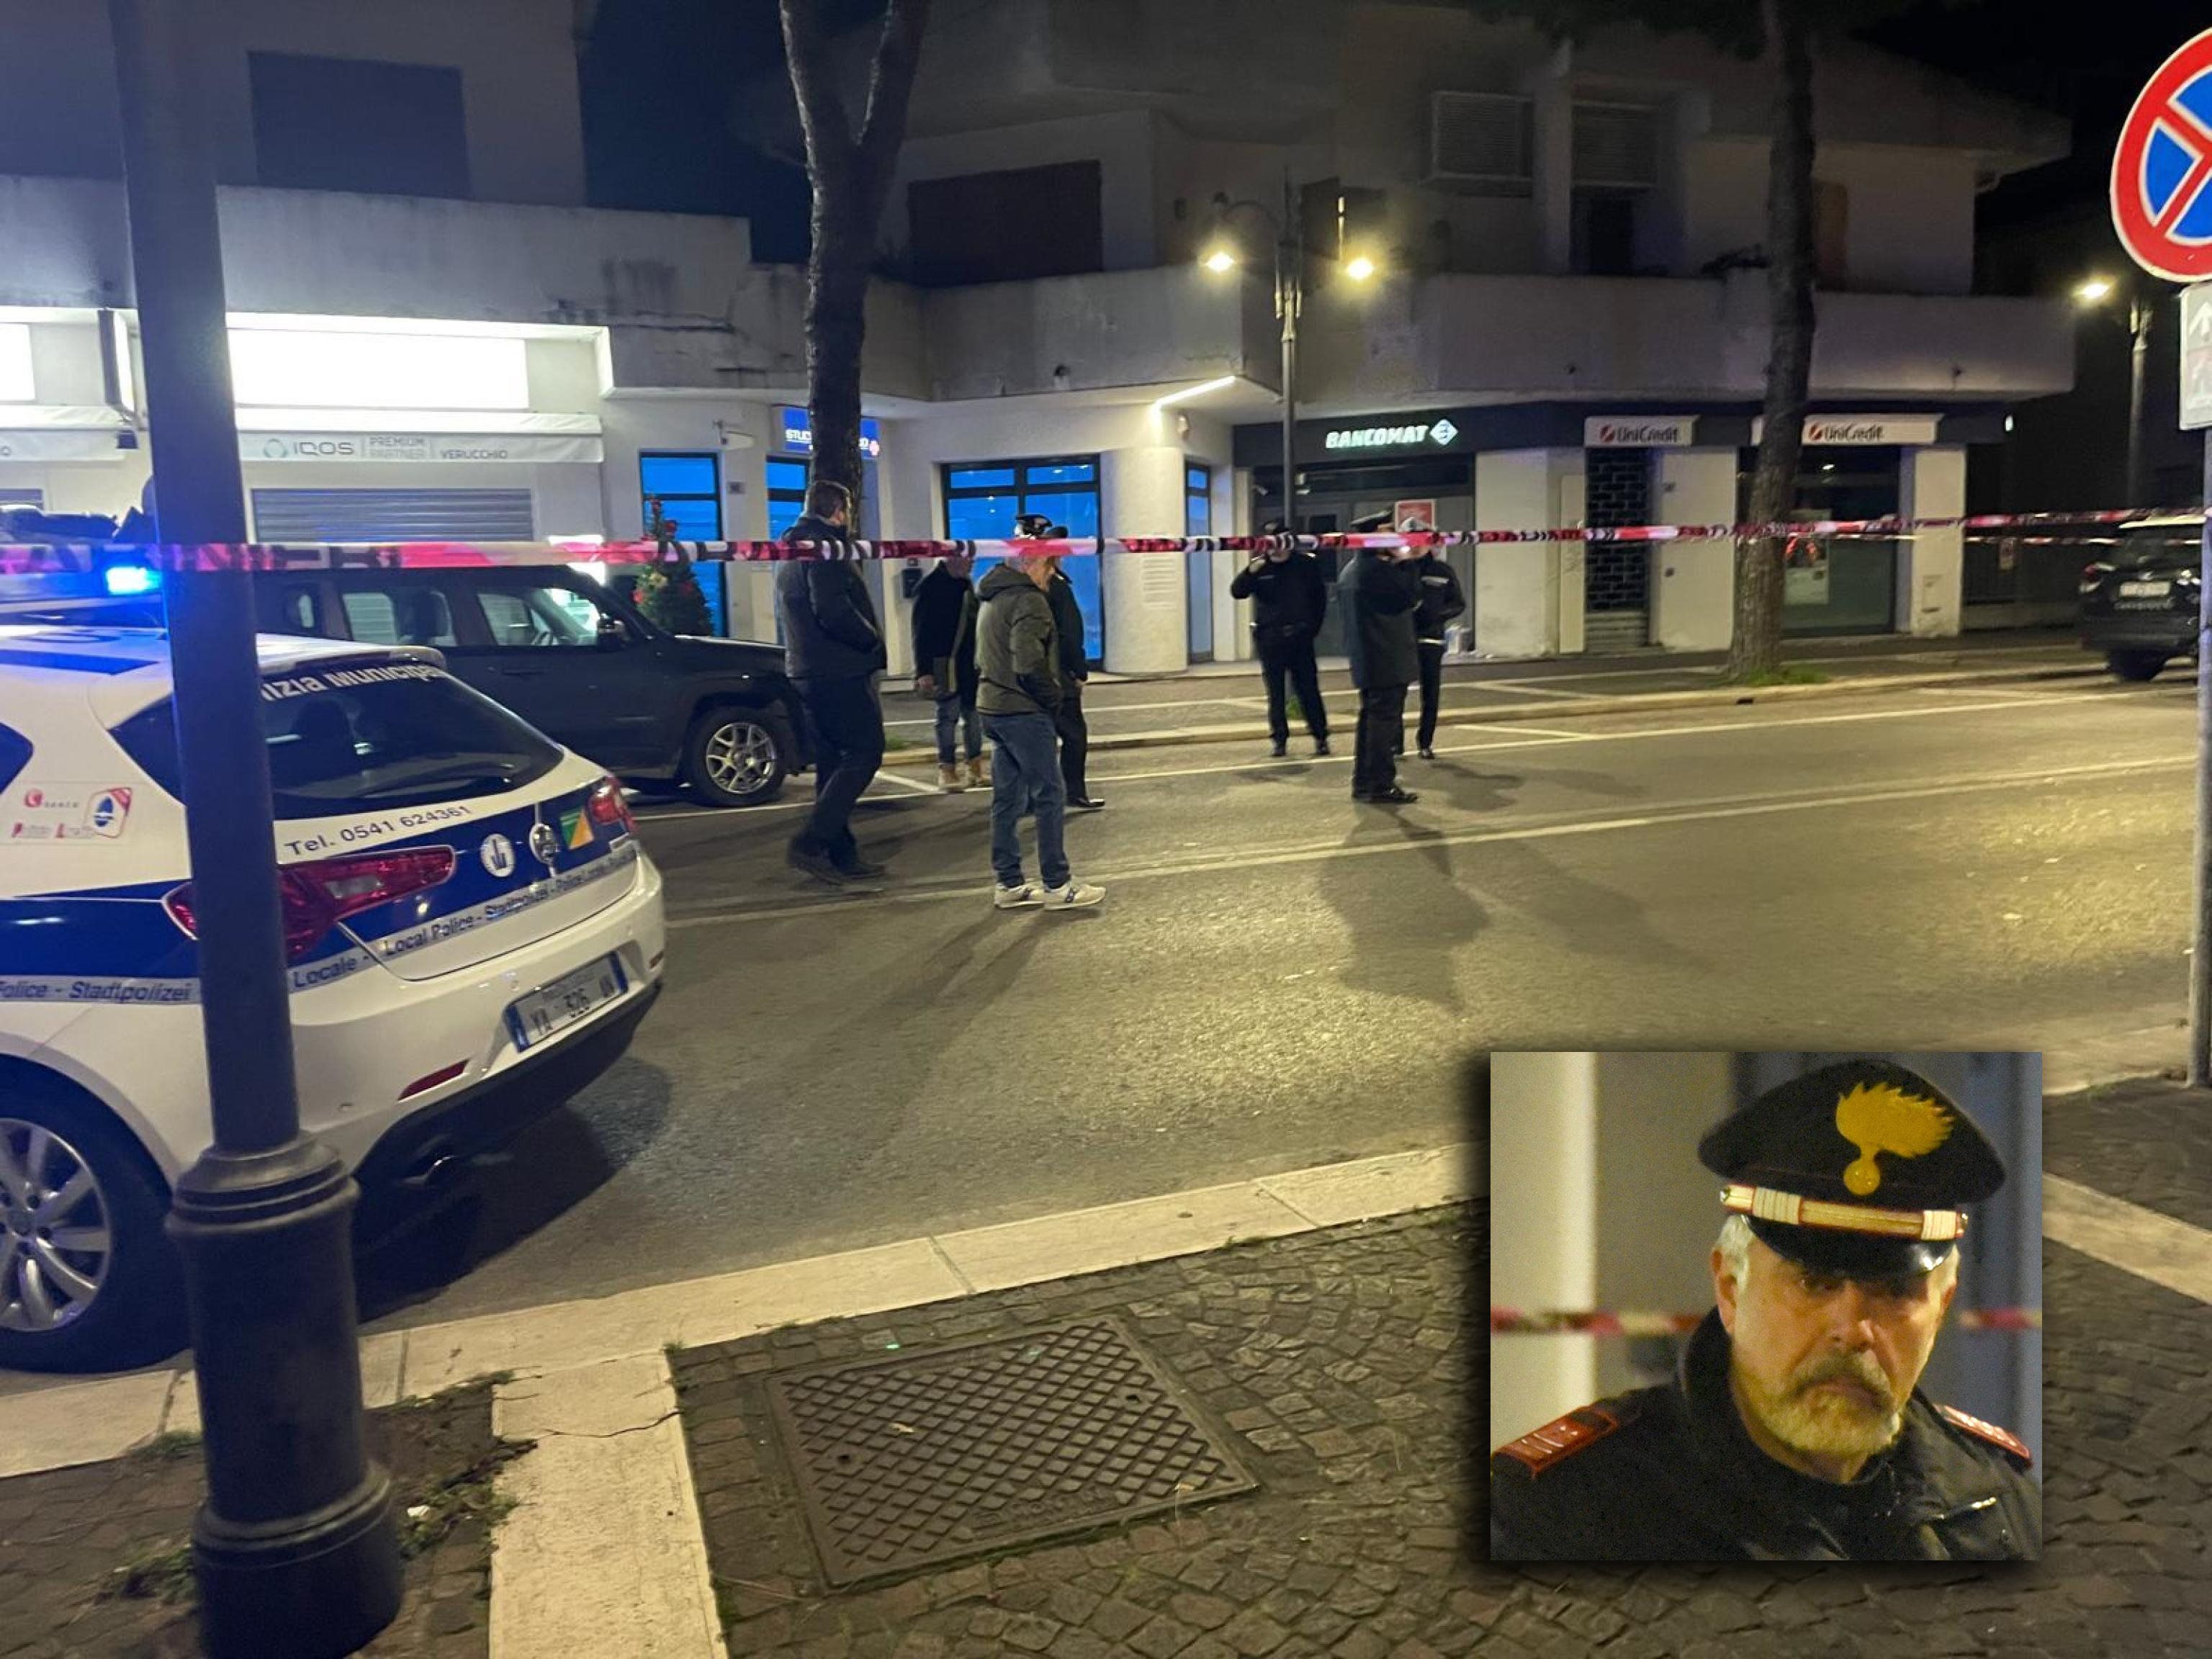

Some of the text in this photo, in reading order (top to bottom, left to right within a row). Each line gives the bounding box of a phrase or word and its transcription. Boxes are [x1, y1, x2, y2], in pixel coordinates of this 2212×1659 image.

[369, 436, 425, 446] PREMIUM
[1326, 425, 1429, 449] BANCOMAT
[1617, 425, 1678, 443] UniCredit
[294, 441, 354, 456] IQOS
[284, 835, 336, 855] Tel.
[341, 821, 395, 842] 0541
[293, 956, 357, 988] Locale
[383, 928, 427, 956] Local
